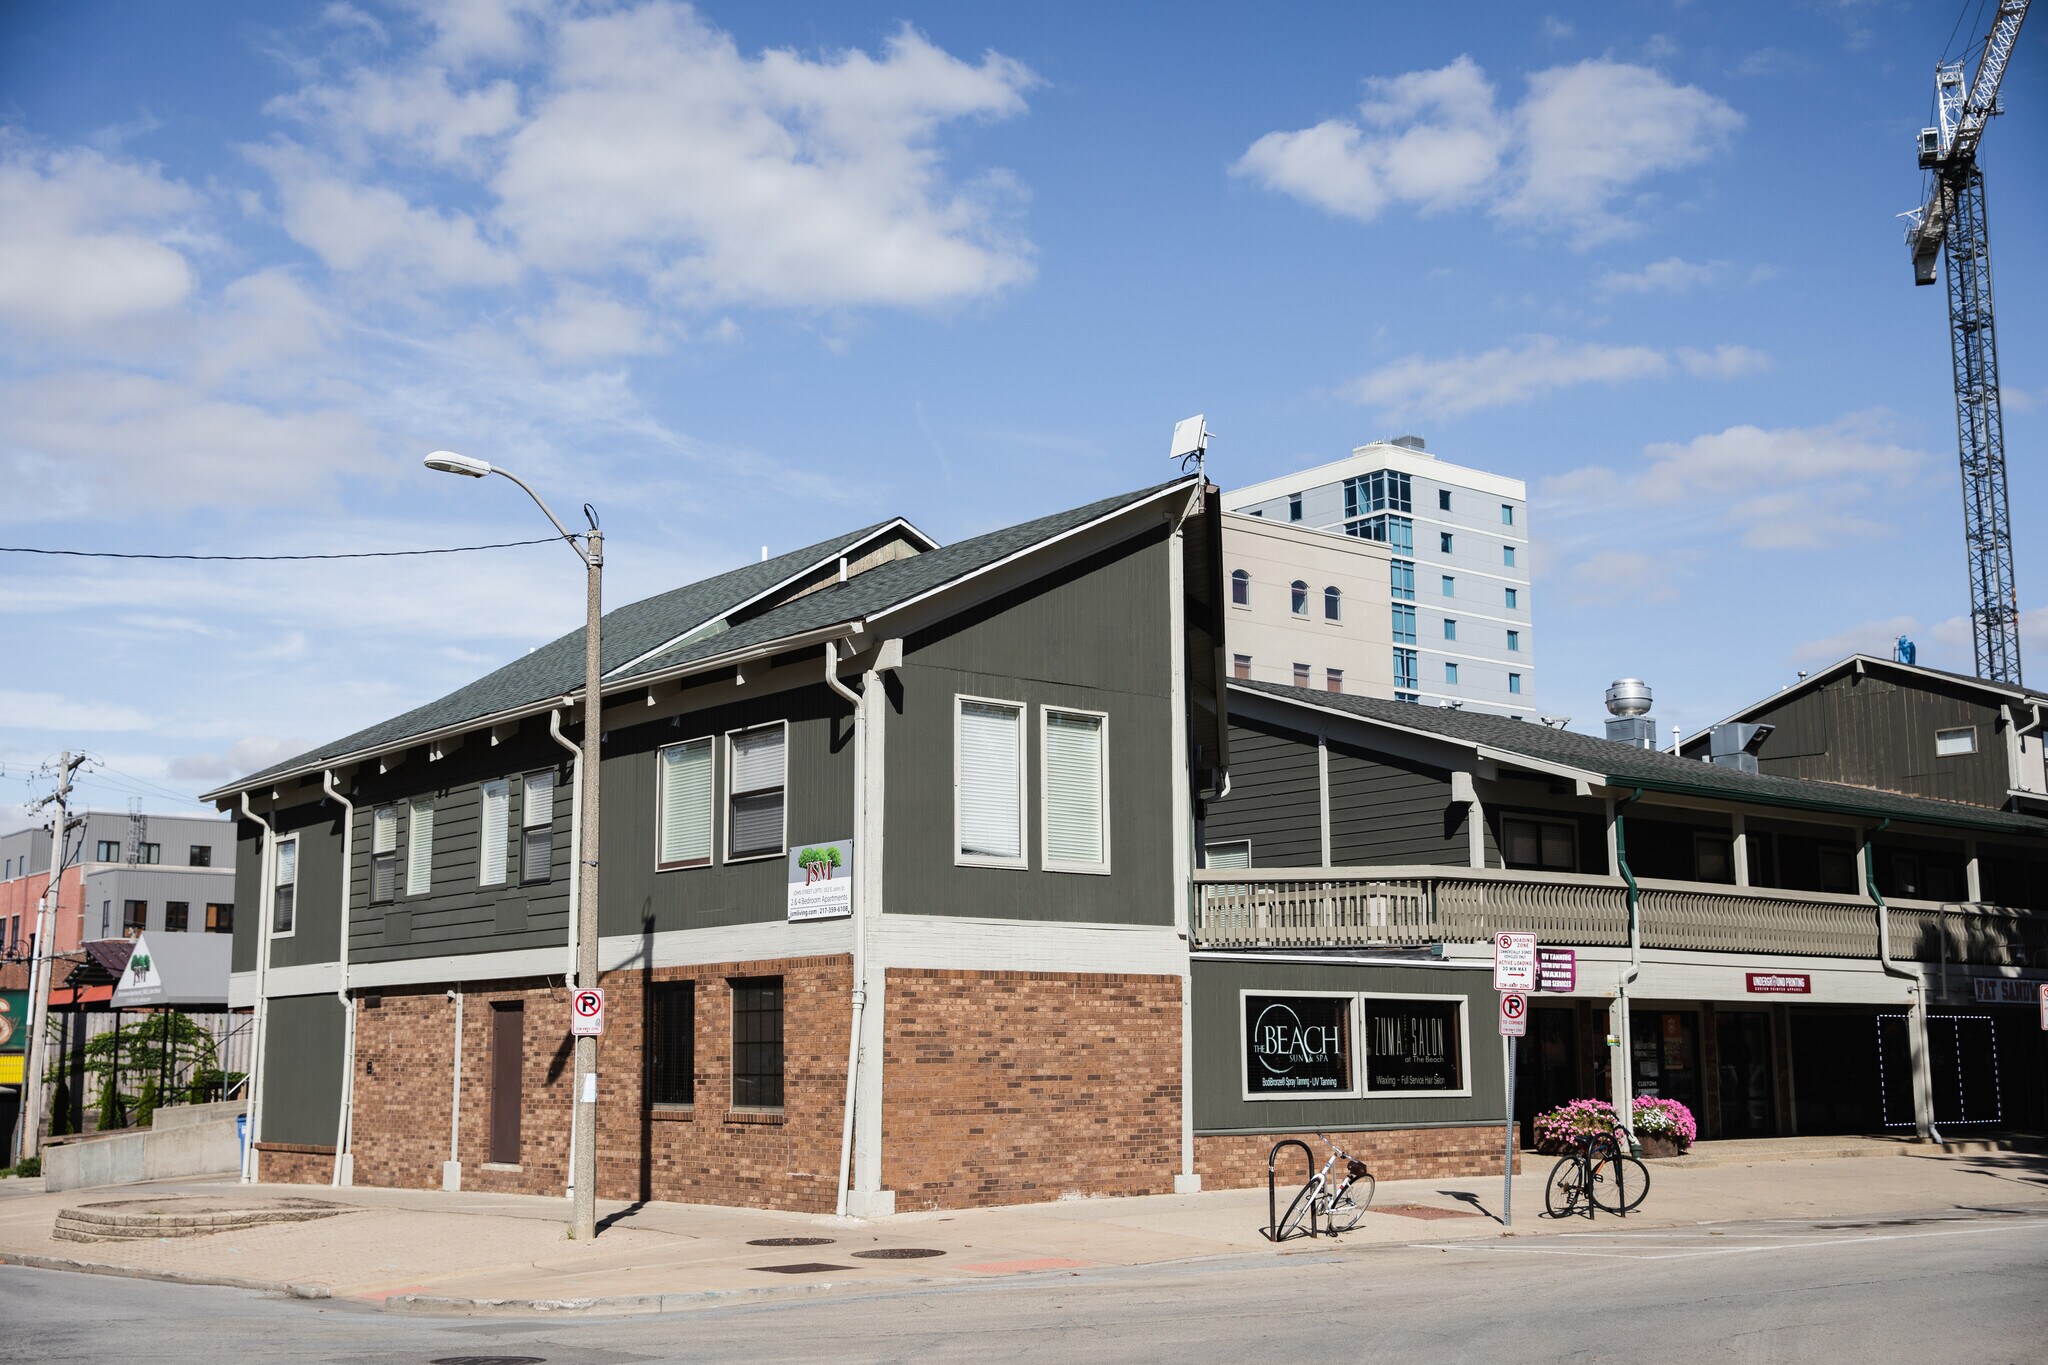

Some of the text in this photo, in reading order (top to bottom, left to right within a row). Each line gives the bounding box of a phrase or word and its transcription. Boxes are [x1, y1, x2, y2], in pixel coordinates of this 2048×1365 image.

[806, 860, 832, 886] JSM
[802, 896, 821, 904] Bedroom
[822, 894, 848, 903] Apartments
[1786, 977, 1805, 987] PRINTING
[1375, 1017, 1403, 1055] ZUMA
[1412, 1017, 1443, 1055] SALON
[1253, 1025, 1339, 1062] THE BEACH
[1286, 1077, 1296, 1088] Spray
[1312, 1077, 1320, 1086] UV
[1320, 1077, 1337, 1088] Tanning
[1376, 1075, 1396, 1087] Waxing
[1409, 1075, 1424, 1084] Service
[1425, 1076, 1433, 1084] Hair
[1434, 1075, 1445, 1084] Salon
